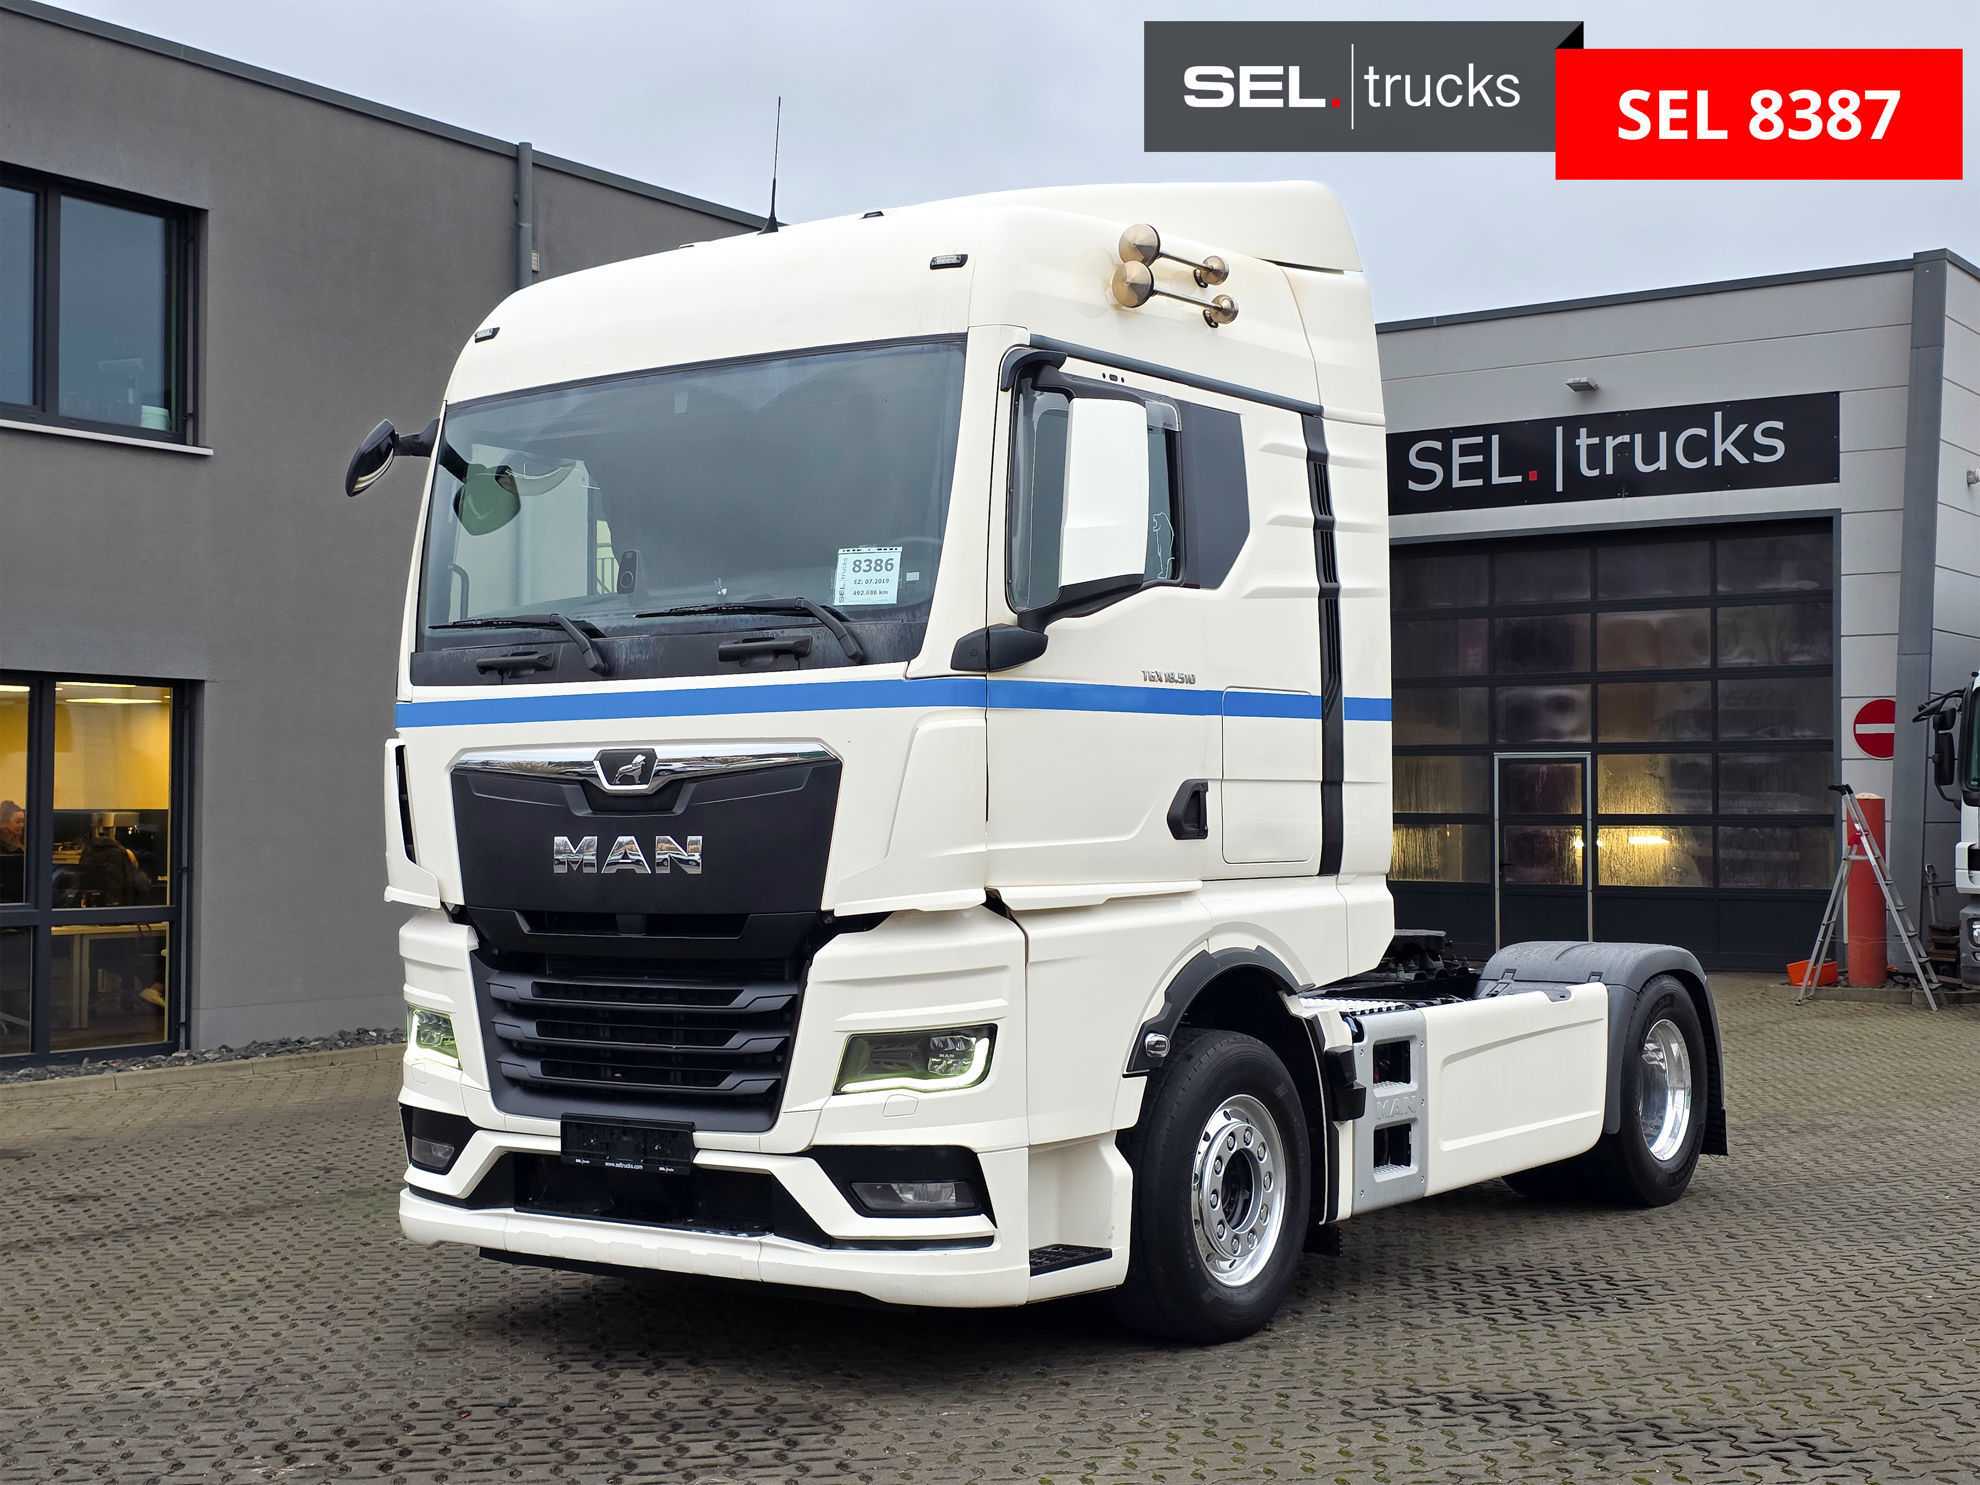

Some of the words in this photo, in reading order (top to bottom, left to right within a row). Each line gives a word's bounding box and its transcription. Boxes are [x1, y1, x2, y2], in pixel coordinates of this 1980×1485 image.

[1575, 411, 1786, 478] trucks
[852, 558, 894, 573] 8386
[1142, 670, 1163, 683] TGX
[553, 836, 703, 873] MAN
